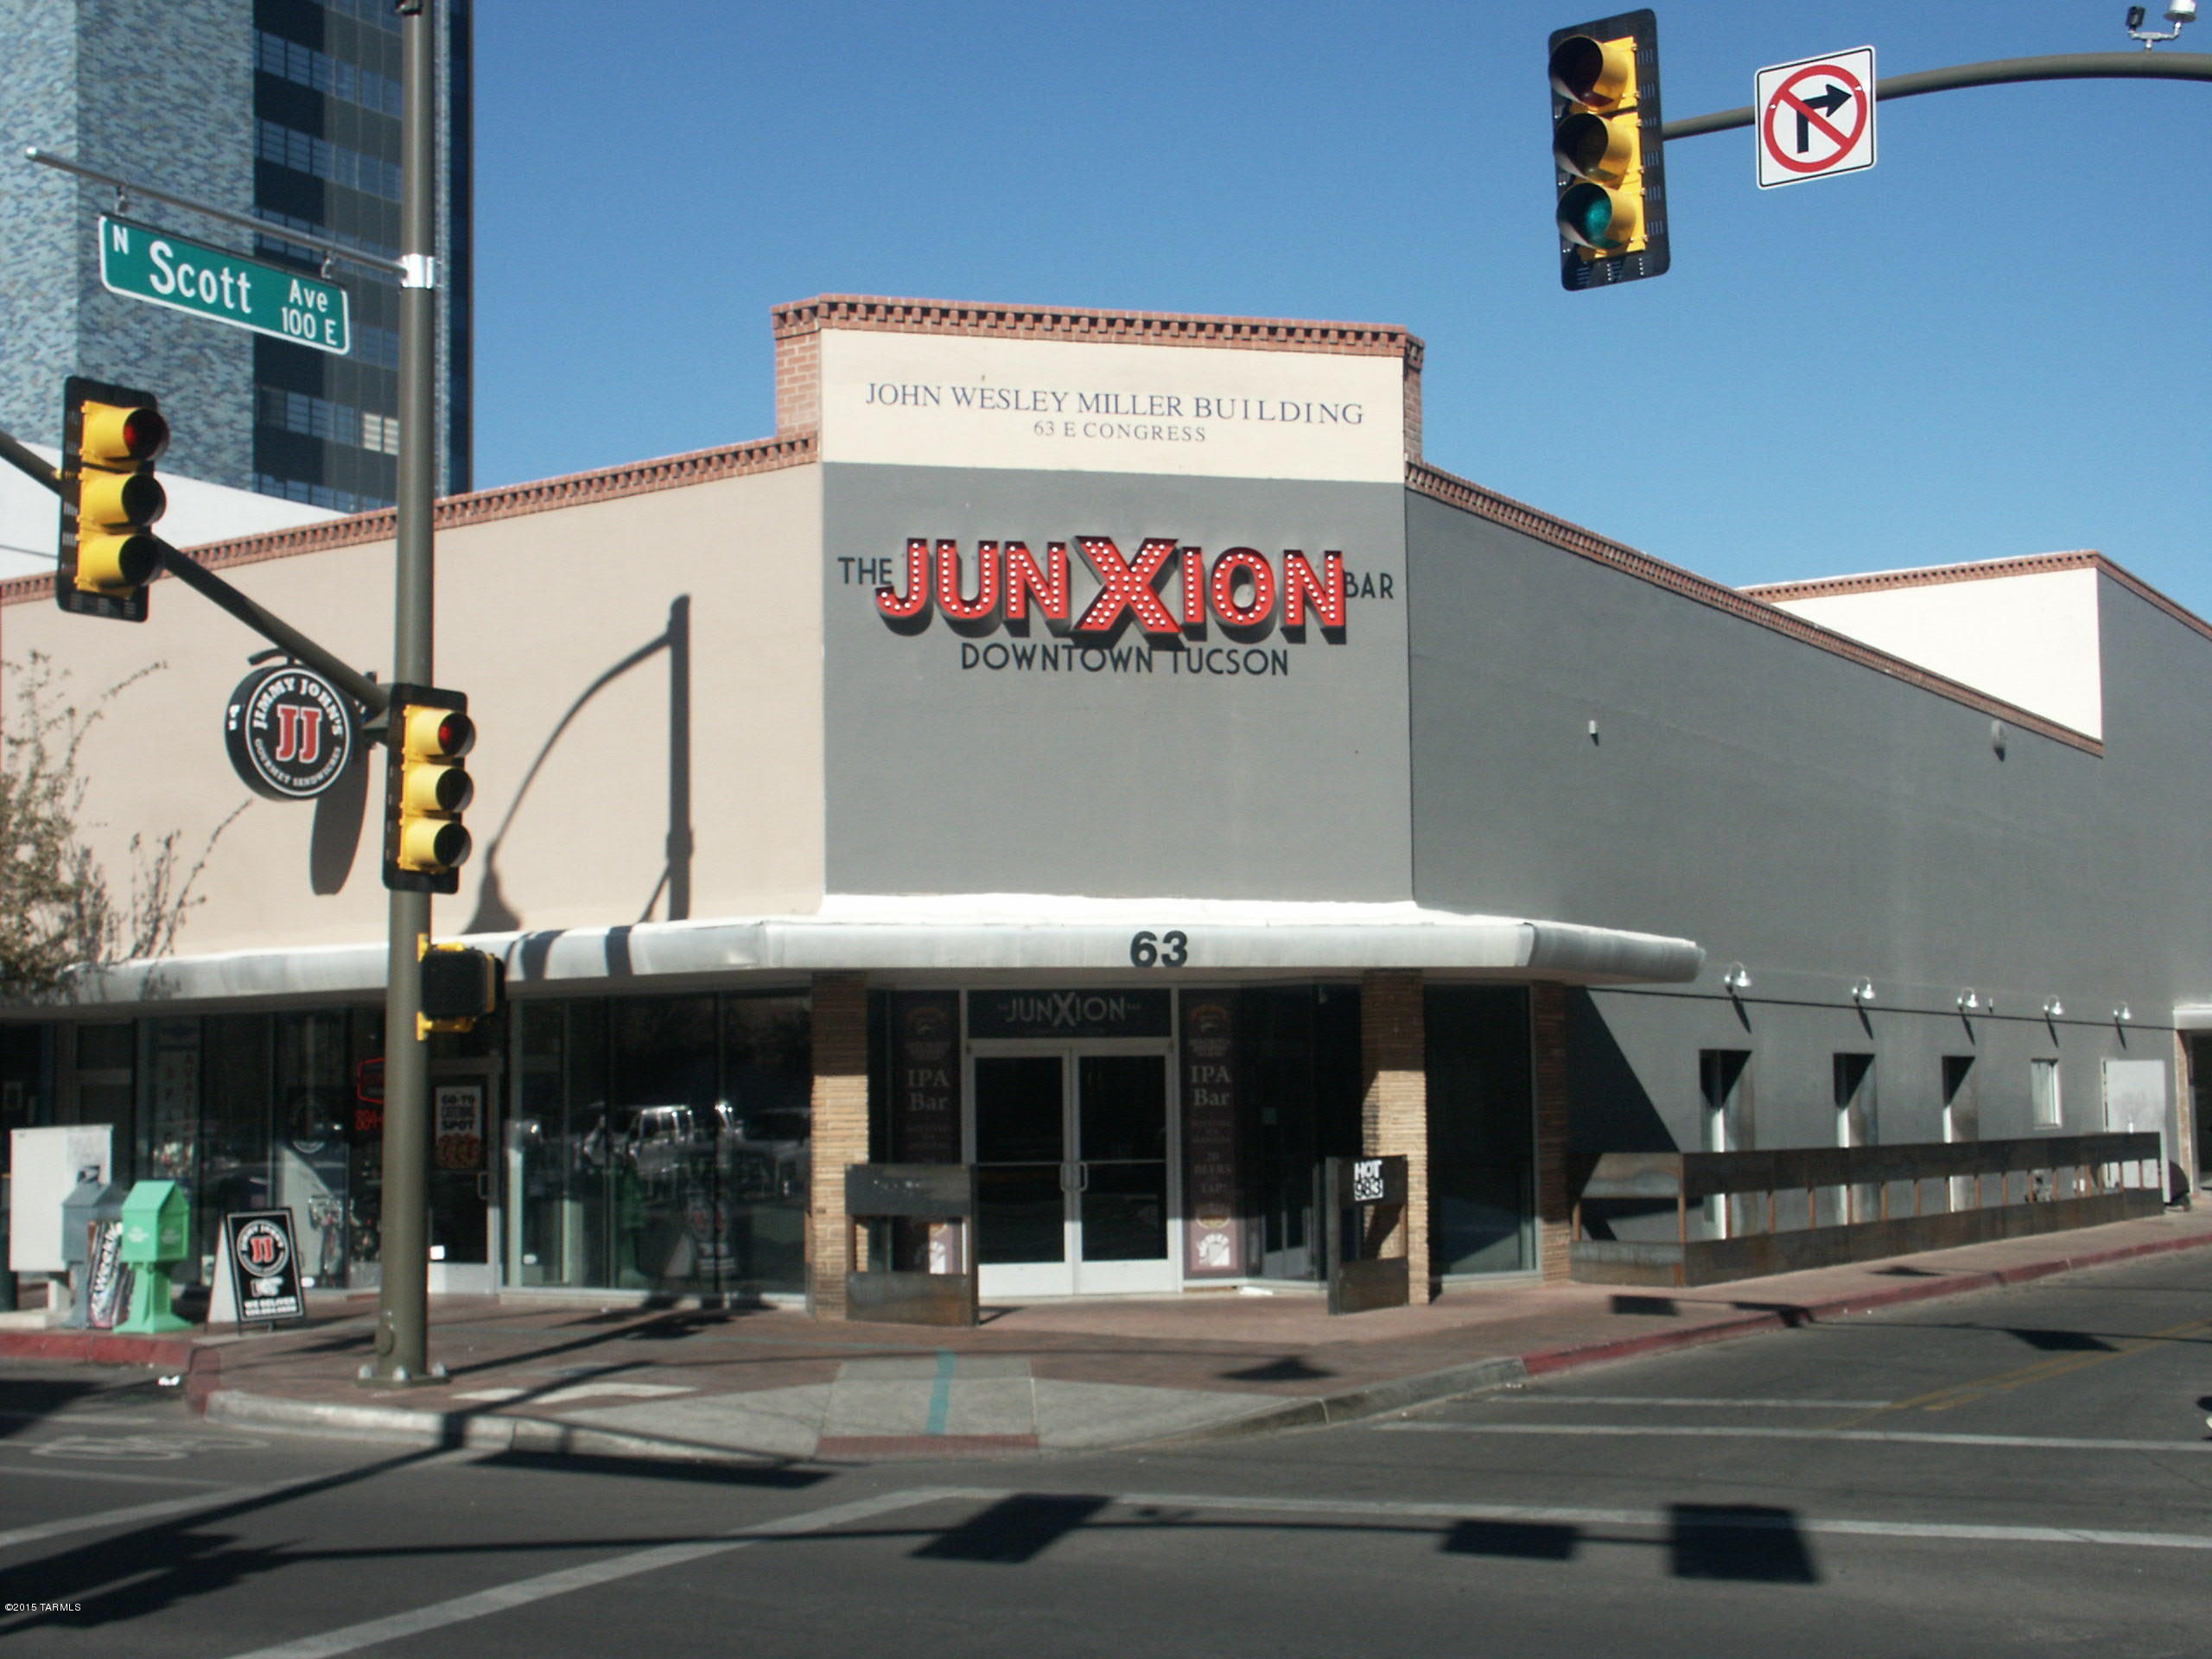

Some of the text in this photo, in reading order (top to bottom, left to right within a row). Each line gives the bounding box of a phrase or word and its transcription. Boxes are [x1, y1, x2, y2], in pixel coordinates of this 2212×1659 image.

[112, 225, 251, 314] N Scott
[289, 278, 328, 312] Ave
[282, 307, 338, 346] 100 E
[866, 383, 1363, 425] JOHN WESLEY MILLER BUILDING
[1033, 420, 1206, 442] 63 E CONGRESS
[837, 536, 1394, 638] THE JUNXION BAR
[961, 642, 1288, 677] DOWNTOWN TUCSON
[252, 677, 296, 730] JIMMY
[275, 703, 323, 764] JJ
[1129, 930, 1188, 969] 63
[1005, 993, 1127, 1028] JUNXION
[906, 1069, 950, 1089] IPA
[1190, 1065, 1233, 1084] IPA
[909, 1091, 949, 1112] Bar
[1193, 1088, 1232, 1107] Bar
[1354, 1160, 1382, 1181] HOT
